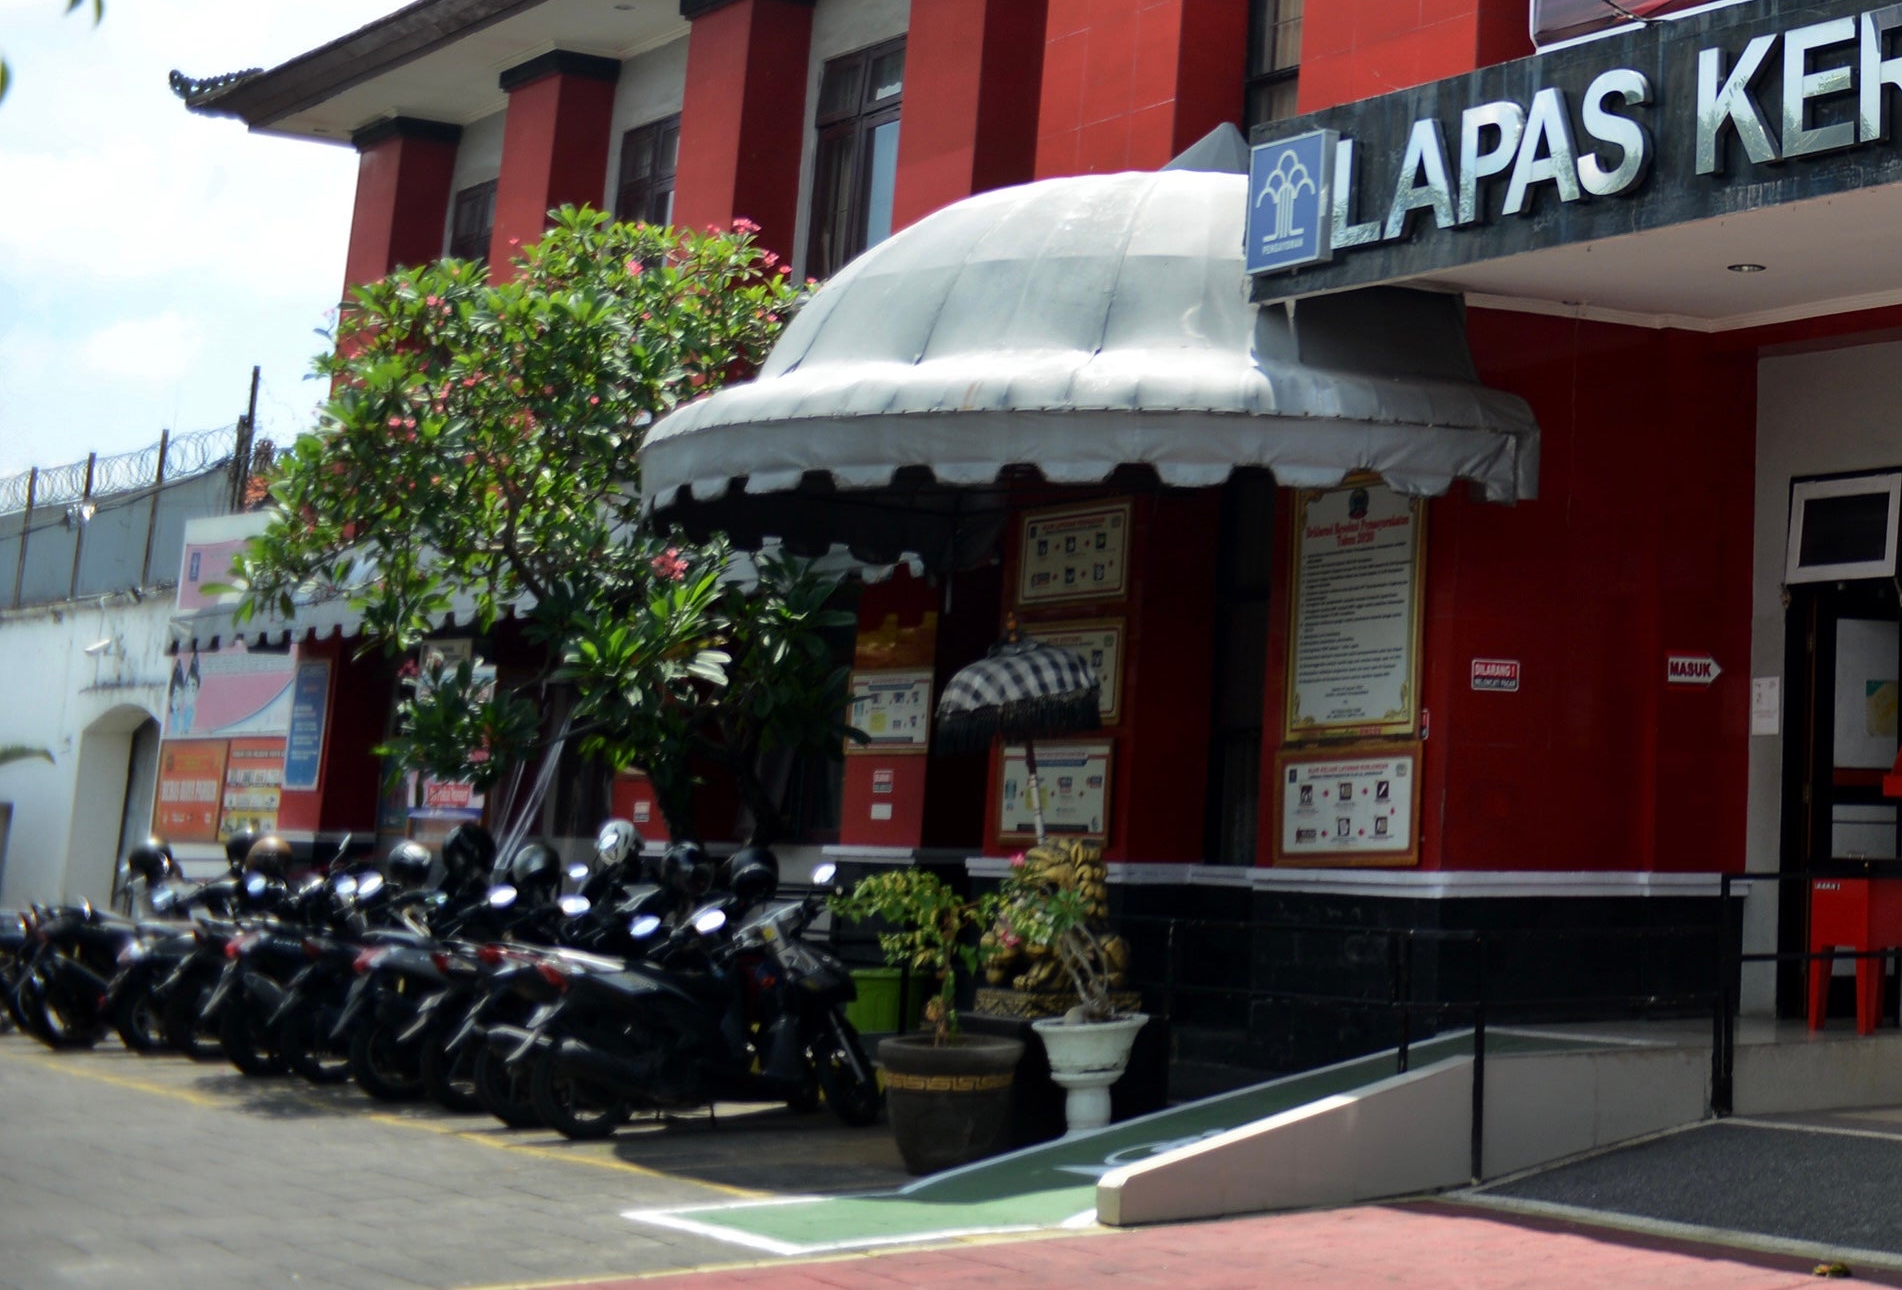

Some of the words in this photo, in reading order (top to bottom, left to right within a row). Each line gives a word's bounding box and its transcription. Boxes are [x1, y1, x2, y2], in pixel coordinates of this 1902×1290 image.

[1330, 68, 1654, 250] LAPAS
[1475, 663, 1511, 678] DILARANG
[1669, 662, 1711, 677] MASUK
